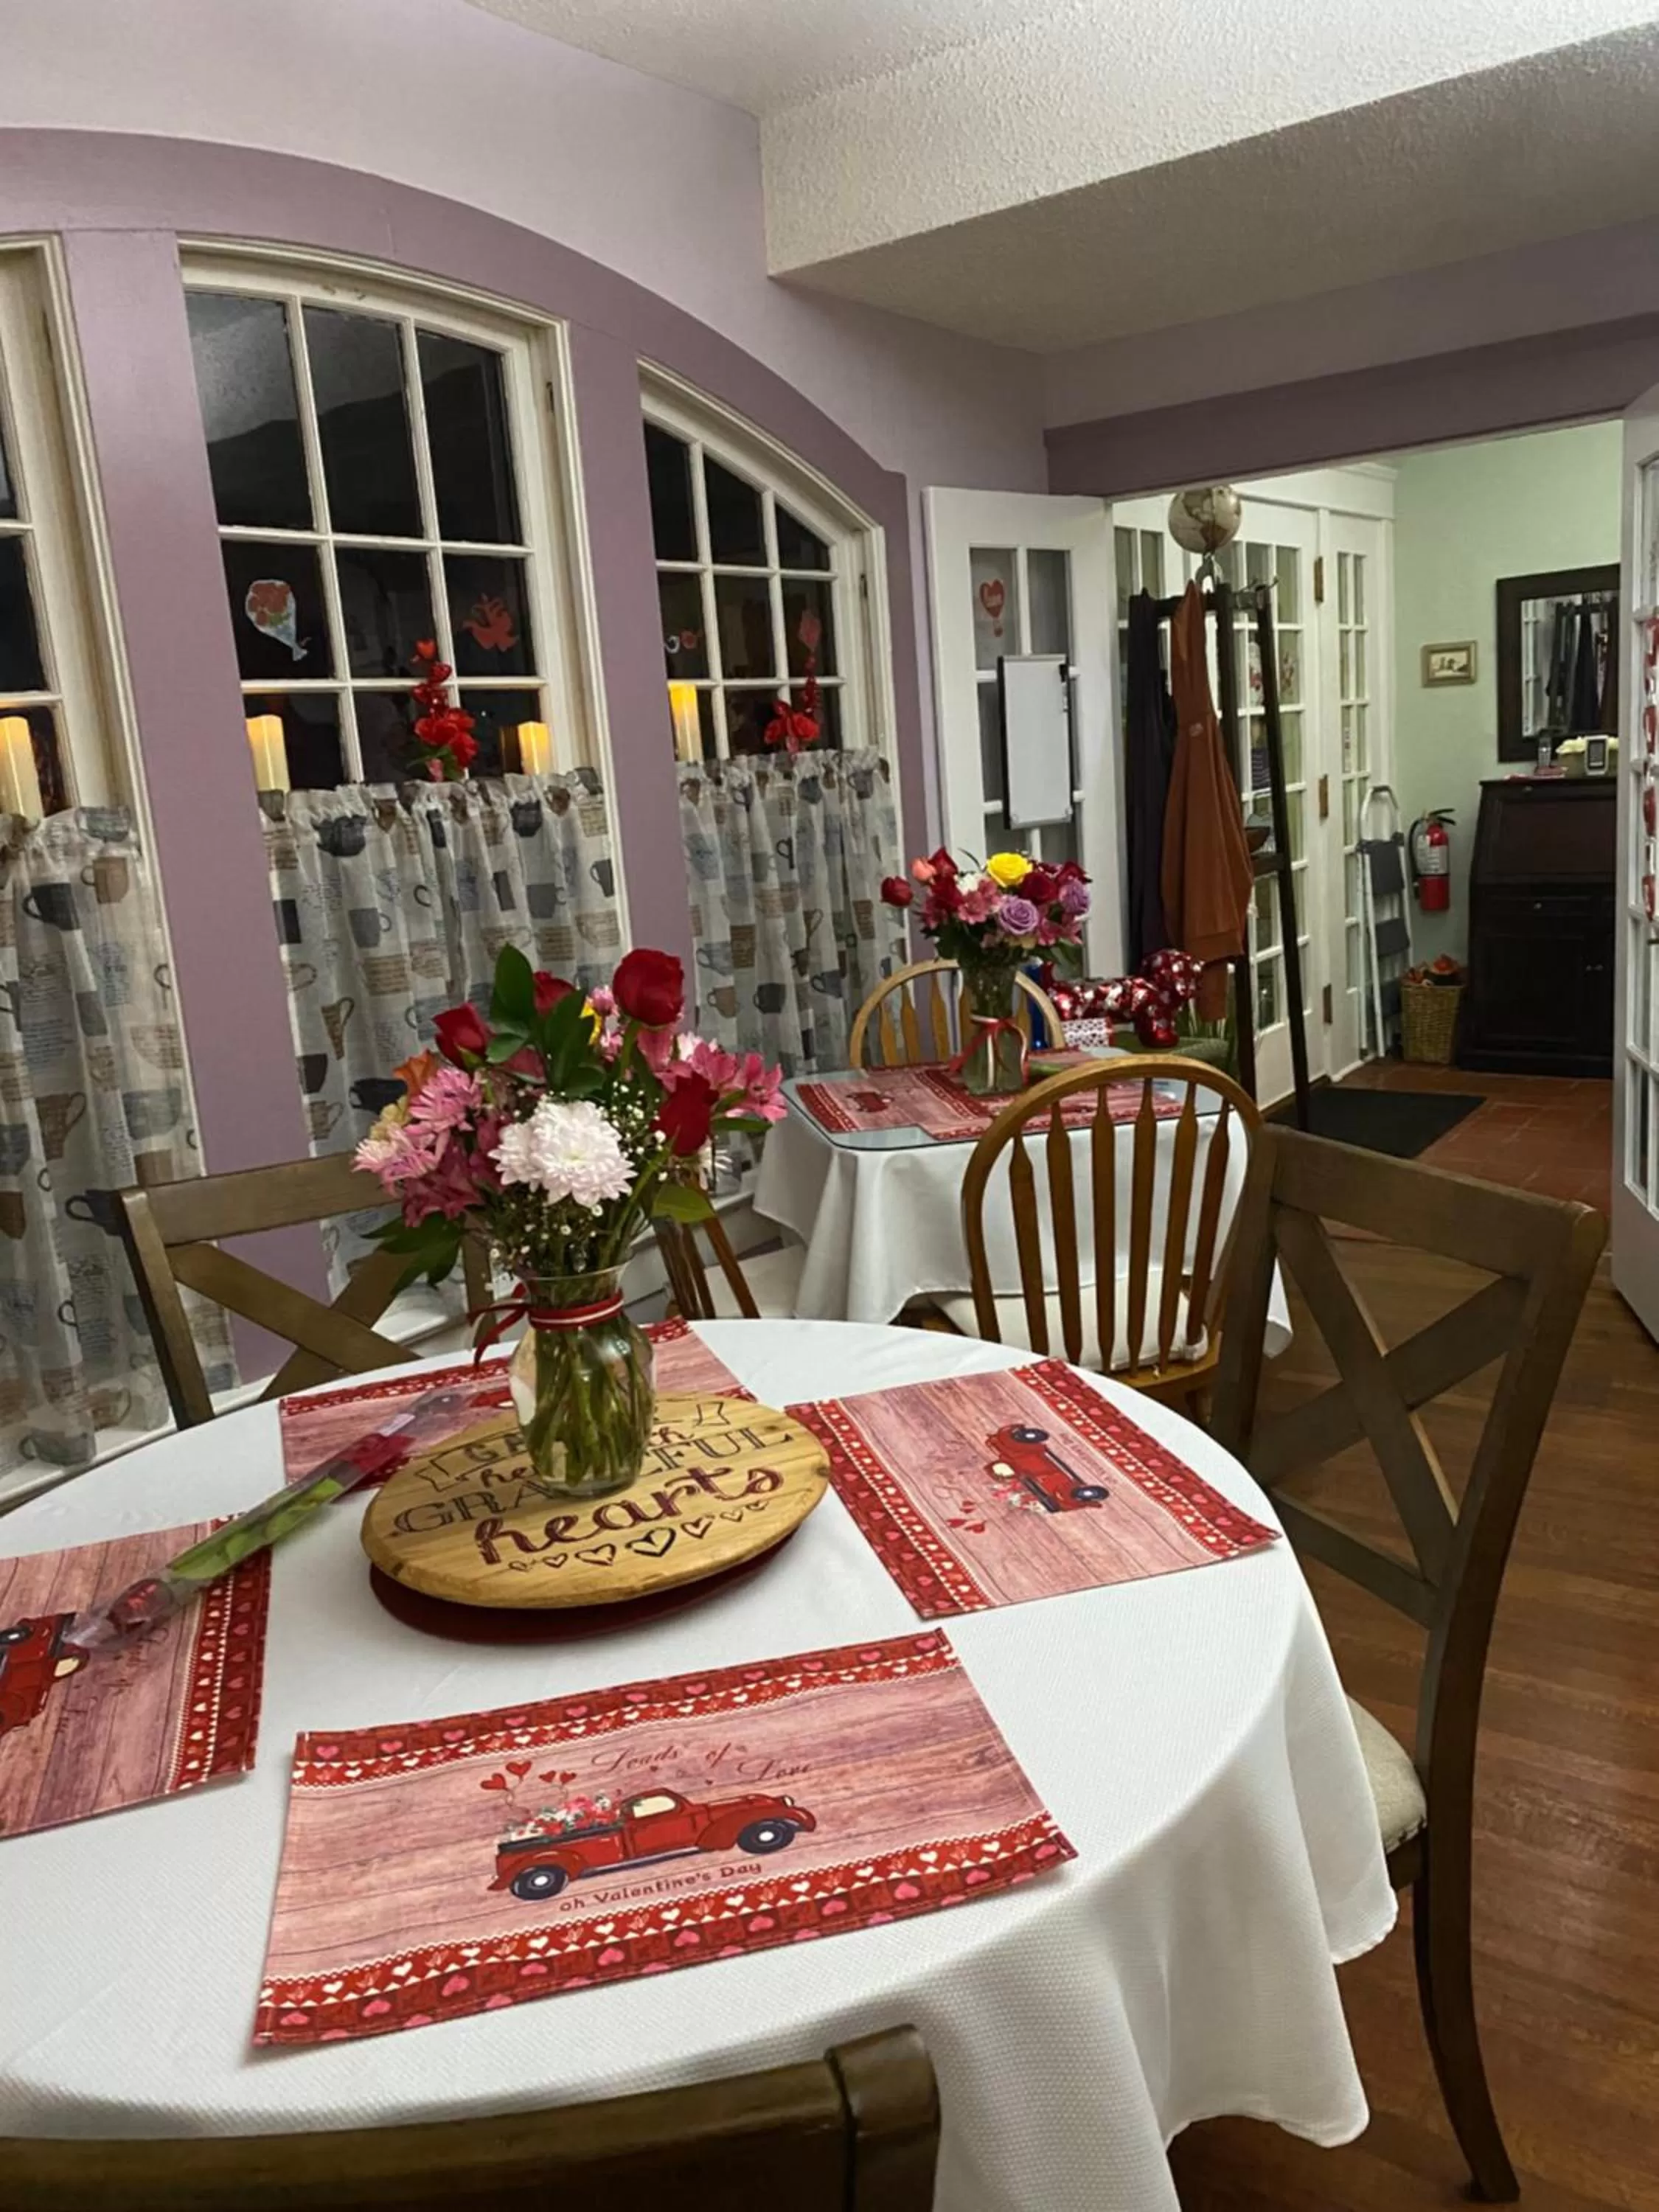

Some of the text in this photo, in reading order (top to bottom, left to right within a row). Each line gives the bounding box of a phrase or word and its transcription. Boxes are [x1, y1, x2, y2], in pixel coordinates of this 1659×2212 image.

[393, 1427, 795, 1537] GRAFUL
[474, 1466, 785, 1565] hearts
[591, 1742, 812, 1781] Loads of Love
[559, 1862, 762, 1913] oh Valentine's Day
